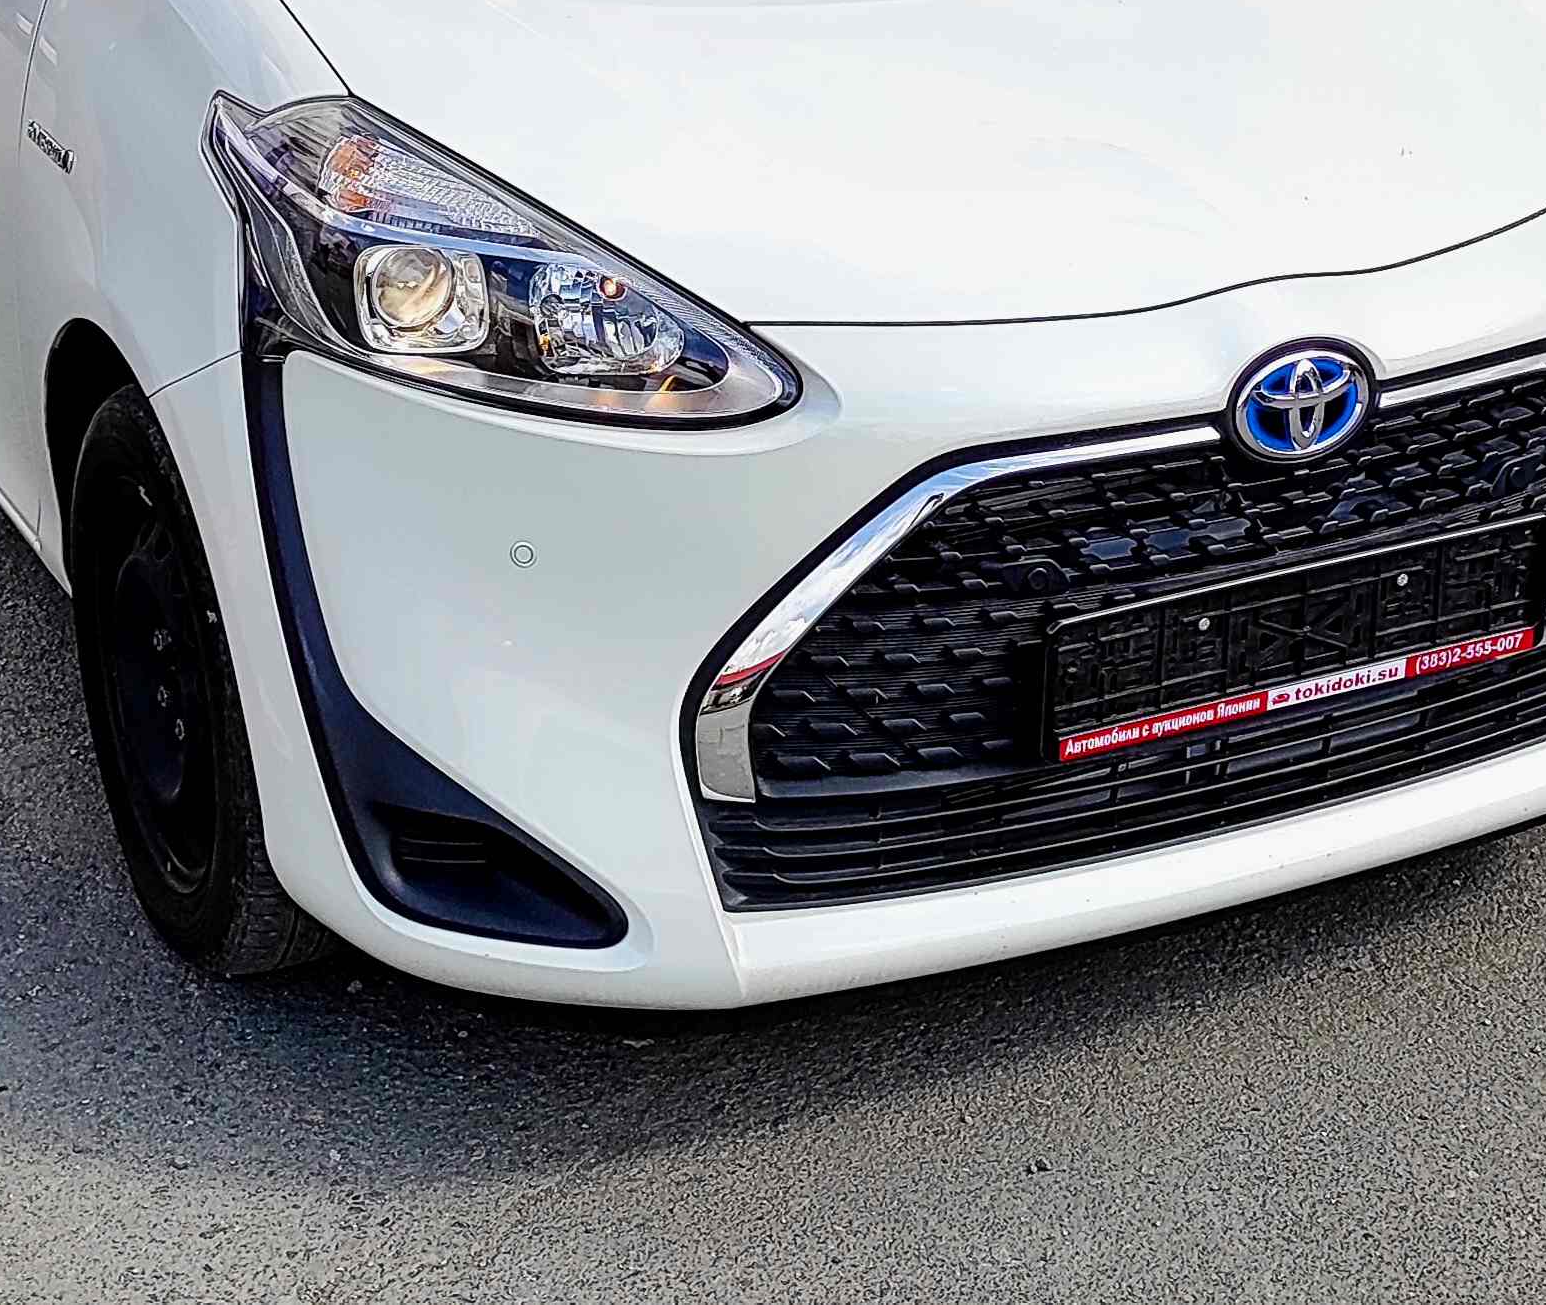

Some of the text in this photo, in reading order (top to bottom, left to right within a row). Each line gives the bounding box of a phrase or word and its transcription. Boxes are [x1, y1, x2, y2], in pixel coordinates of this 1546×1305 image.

[1415, 633, 1524, 676] (383)2-555-007
[1294, 666, 1399, 701] tokidoki.su
[1064, 727, 1140, 756] Автомобили
[1141, 723, 1150, 737] с
[1152, 708, 1214, 738] аукционов
